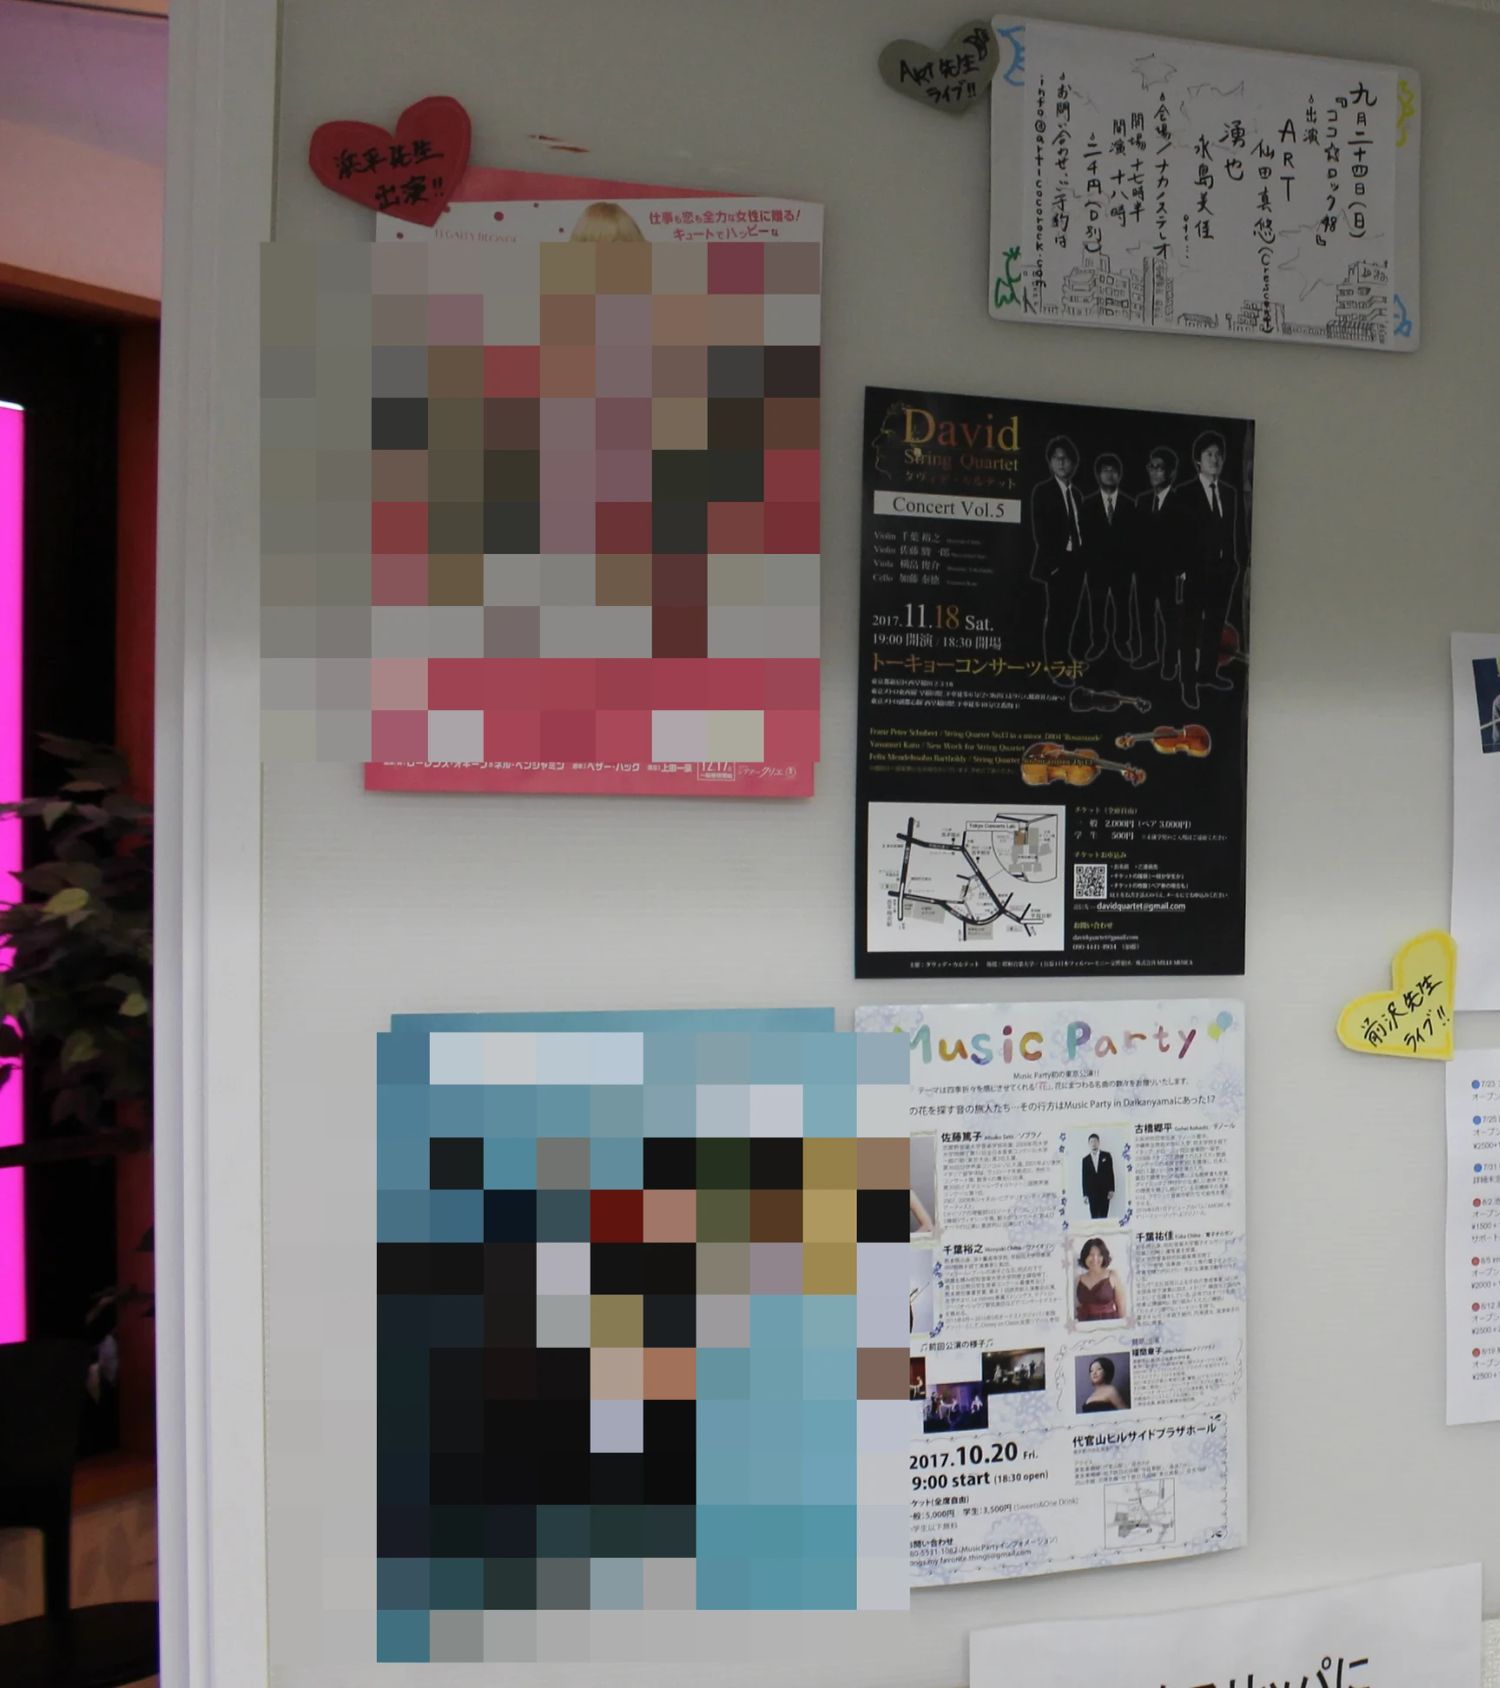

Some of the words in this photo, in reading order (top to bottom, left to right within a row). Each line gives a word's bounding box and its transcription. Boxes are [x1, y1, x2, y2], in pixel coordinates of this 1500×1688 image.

[1302, 105, 1320, 147] 出演
[1278, 118, 1298, 202] ART
[902, 406, 1021, 452] David
[903, 448, 952, 472] String
[960, 452, 1019, 473] Quartet
[892, 496, 955, 516] Concert
[961, 500, 1005, 519] Vol.5
[874, 530, 896, 542] Violin
[964, 615, 995, 631] Sat.
[872, 632, 903, 646] 19:00
[905, 633, 935, 648] 開演
[943, 637, 973, 650] 18:30
[872, 651, 1084, 680] トーキョーコンサーツ・ラボ
[1096, 901, 1187, 913] davidquartet@gmail.com
[1403, 1005, 1451, 1053] ライブ!!
[909, 1024, 1044, 1066] Music
[1066, 1020, 1197, 1061] Party
[1090, 1100, 1112, 1112] Party
[1113, 1100, 1122, 1108] in
[1072, 1422, 1217, 1448] 代官山ヒルサイドプラザホール
[1023, 1450, 1039, 1461] Fri.
[952, 1471, 991, 1489] start
[1023, 1470, 1049, 1484] open)
